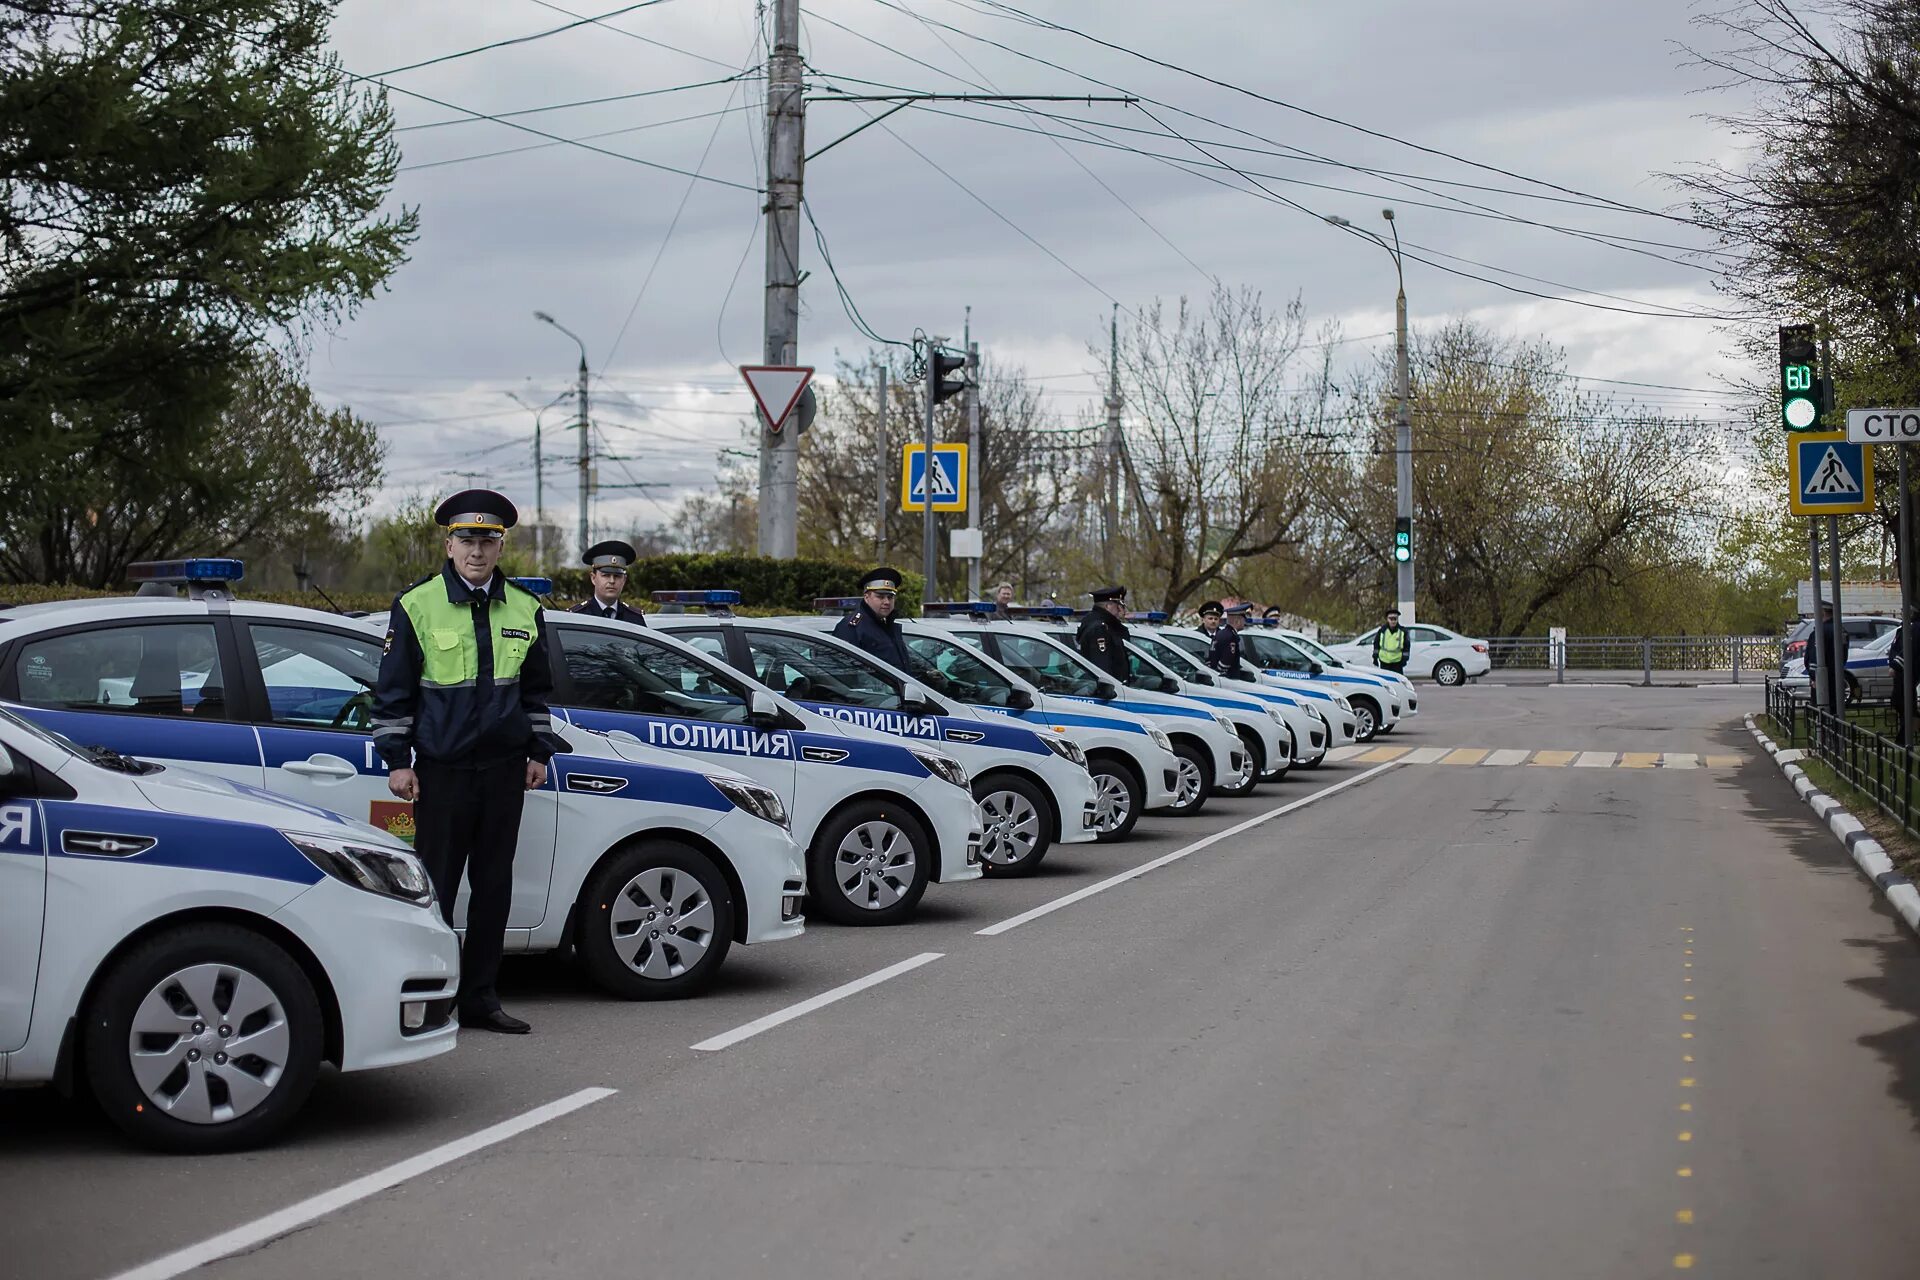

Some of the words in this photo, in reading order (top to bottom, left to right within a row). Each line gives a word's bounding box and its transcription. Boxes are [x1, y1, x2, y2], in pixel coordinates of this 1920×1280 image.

[1786, 365, 1811, 390] 60
[1275, 671, 1311, 680] ПОЛИЦИЯ
[648, 721, 790, 756] ПОЛИЦИЯ
